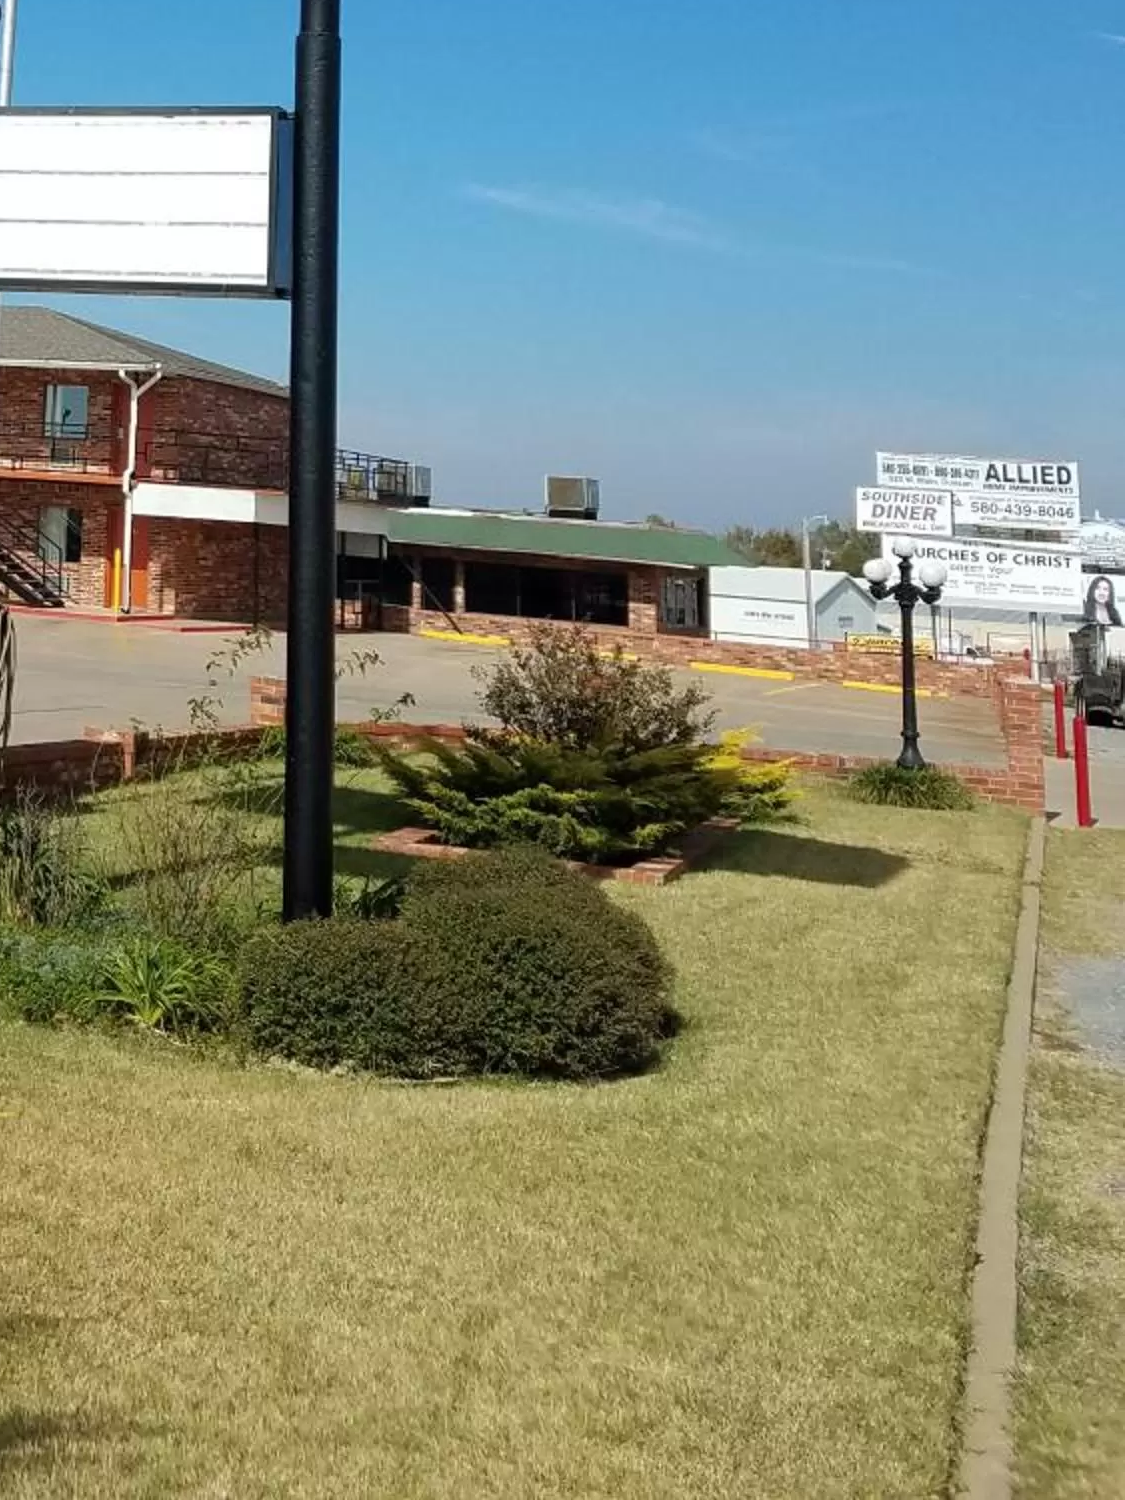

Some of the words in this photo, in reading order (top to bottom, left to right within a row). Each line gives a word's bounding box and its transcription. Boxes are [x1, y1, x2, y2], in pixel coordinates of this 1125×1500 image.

[985, 463, 1072, 485] ALLIED
[861, 490, 948, 505] SOUTHSIDE
[871, 503, 937, 521] DINER
[892, 547, 980, 562] URCHES
[986, 551, 1008, 564] OF
[1012, 553, 1071, 569] CHRIST
